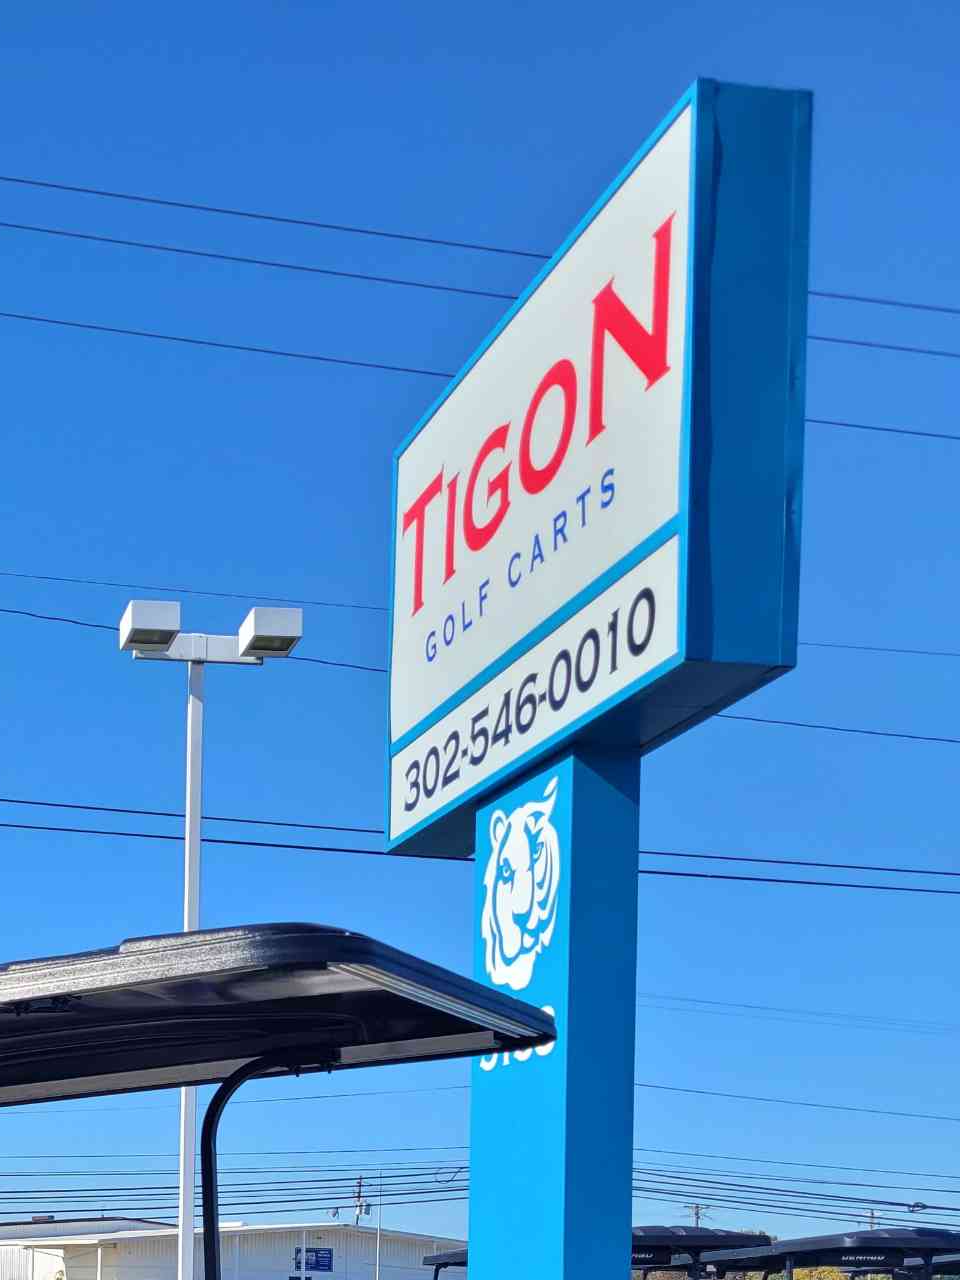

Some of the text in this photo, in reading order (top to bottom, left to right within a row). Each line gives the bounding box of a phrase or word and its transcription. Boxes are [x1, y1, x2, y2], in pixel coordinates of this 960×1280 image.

[401, 211, 677, 616] TIGON
[425, 467, 617, 664] GOLF CARTS
[403, 586, 657, 813] 302-546-0010
